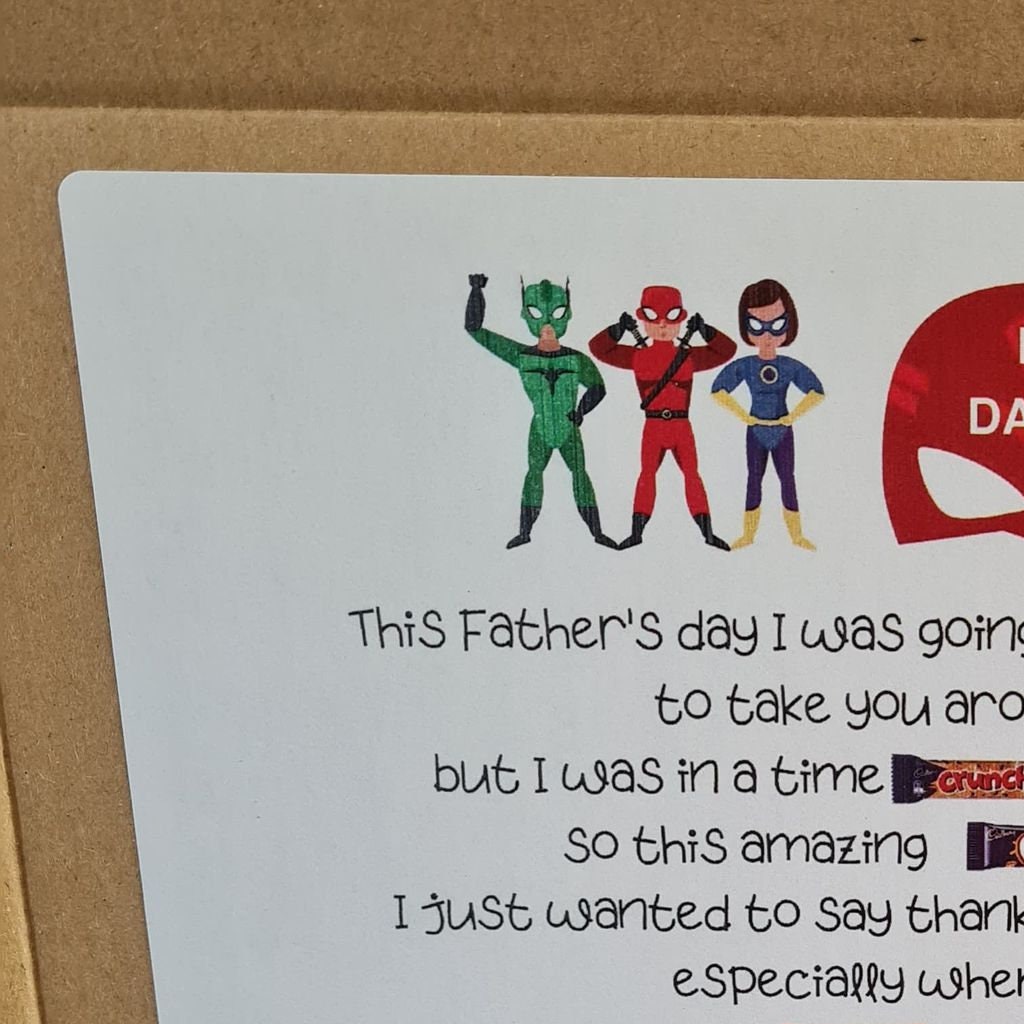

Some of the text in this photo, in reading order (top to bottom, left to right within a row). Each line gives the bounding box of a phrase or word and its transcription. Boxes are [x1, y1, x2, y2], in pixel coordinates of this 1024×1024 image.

[348, 606, 446, 649] This
[459, 608, 663, 651] Father's
[678, 610, 758, 656] day
[773, 613, 787, 651] I
[801, 613, 904, 653] was
[654, 683, 711, 725] to
[726, 684, 831, 726] take
[845, 690, 930, 730] you
[434, 753, 519, 794] but
[533, 757, 548, 793] I
[562, 757, 664, 795] was
[678, 758, 718, 794] in
[733, 760, 757, 794] a
[771, 755, 884, 796] time
[564, 827, 619, 863] so
[632, 825, 727, 865] this
[741, 830, 928, 871] amazing
[393, 895, 408, 929] I
[421, 893, 532, 935] just
[546, 894, 731, 932] wanted
[745, 894, 800, 933] to
[815, 896, 892, 937] say
[673, 962, 904, 1005] especially
